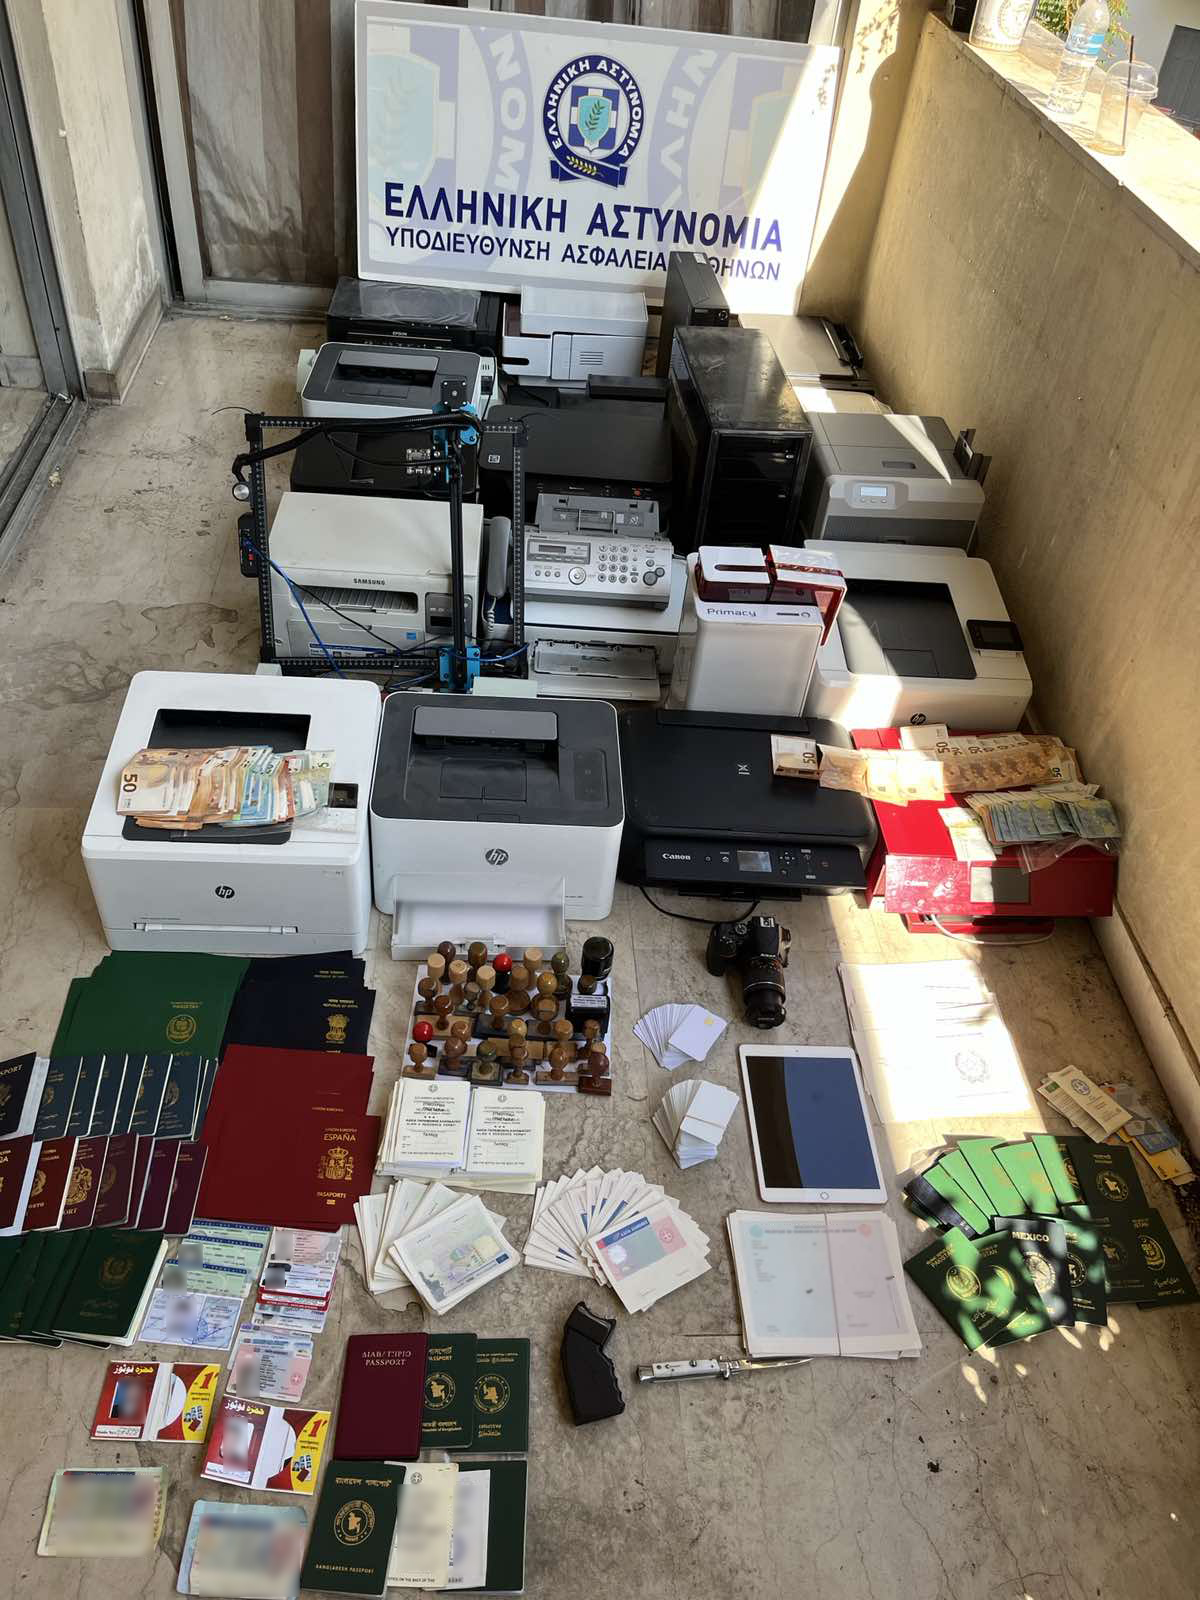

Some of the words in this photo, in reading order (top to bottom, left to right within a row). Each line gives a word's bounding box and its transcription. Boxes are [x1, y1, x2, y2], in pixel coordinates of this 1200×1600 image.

[547, 59, 591, 150] ΕΛΛΗΝΙΚΗ
[596, 59, 642, 157] ΑΣΤΥΝΟΜΙΑ
[385, 181, 567, 233] ΕΛΛΗΝΙΚΗ
[586, 202, 782, 252] ΑΣΤΥΝΟΜΙΑ
[386, 226, 550, 261] ΥΠΟΔΙΕΥΘΥΝΣΗ
[561, 243, 668, 272] ΑΣΦΑΛΕΙΑ
[706, 256, 781, 281] ΘΗΝΩΝ
[353, 578, 386, 586] SAMSUNG
[706, 607, 757, 617] Primacy
[803, 752, 816, 765] 50
[1051, 767, 1061, 778] 50
[123, 773, 138, 793] 50
[485, 848, 509, 865] hp
[662, 853, 691, 861] Canon
[215, 885, 235, 899] hp
[324, 1132, 356, 1141] ESPAÑA
[315, 1563, 349, 1571] BANGLADESH
